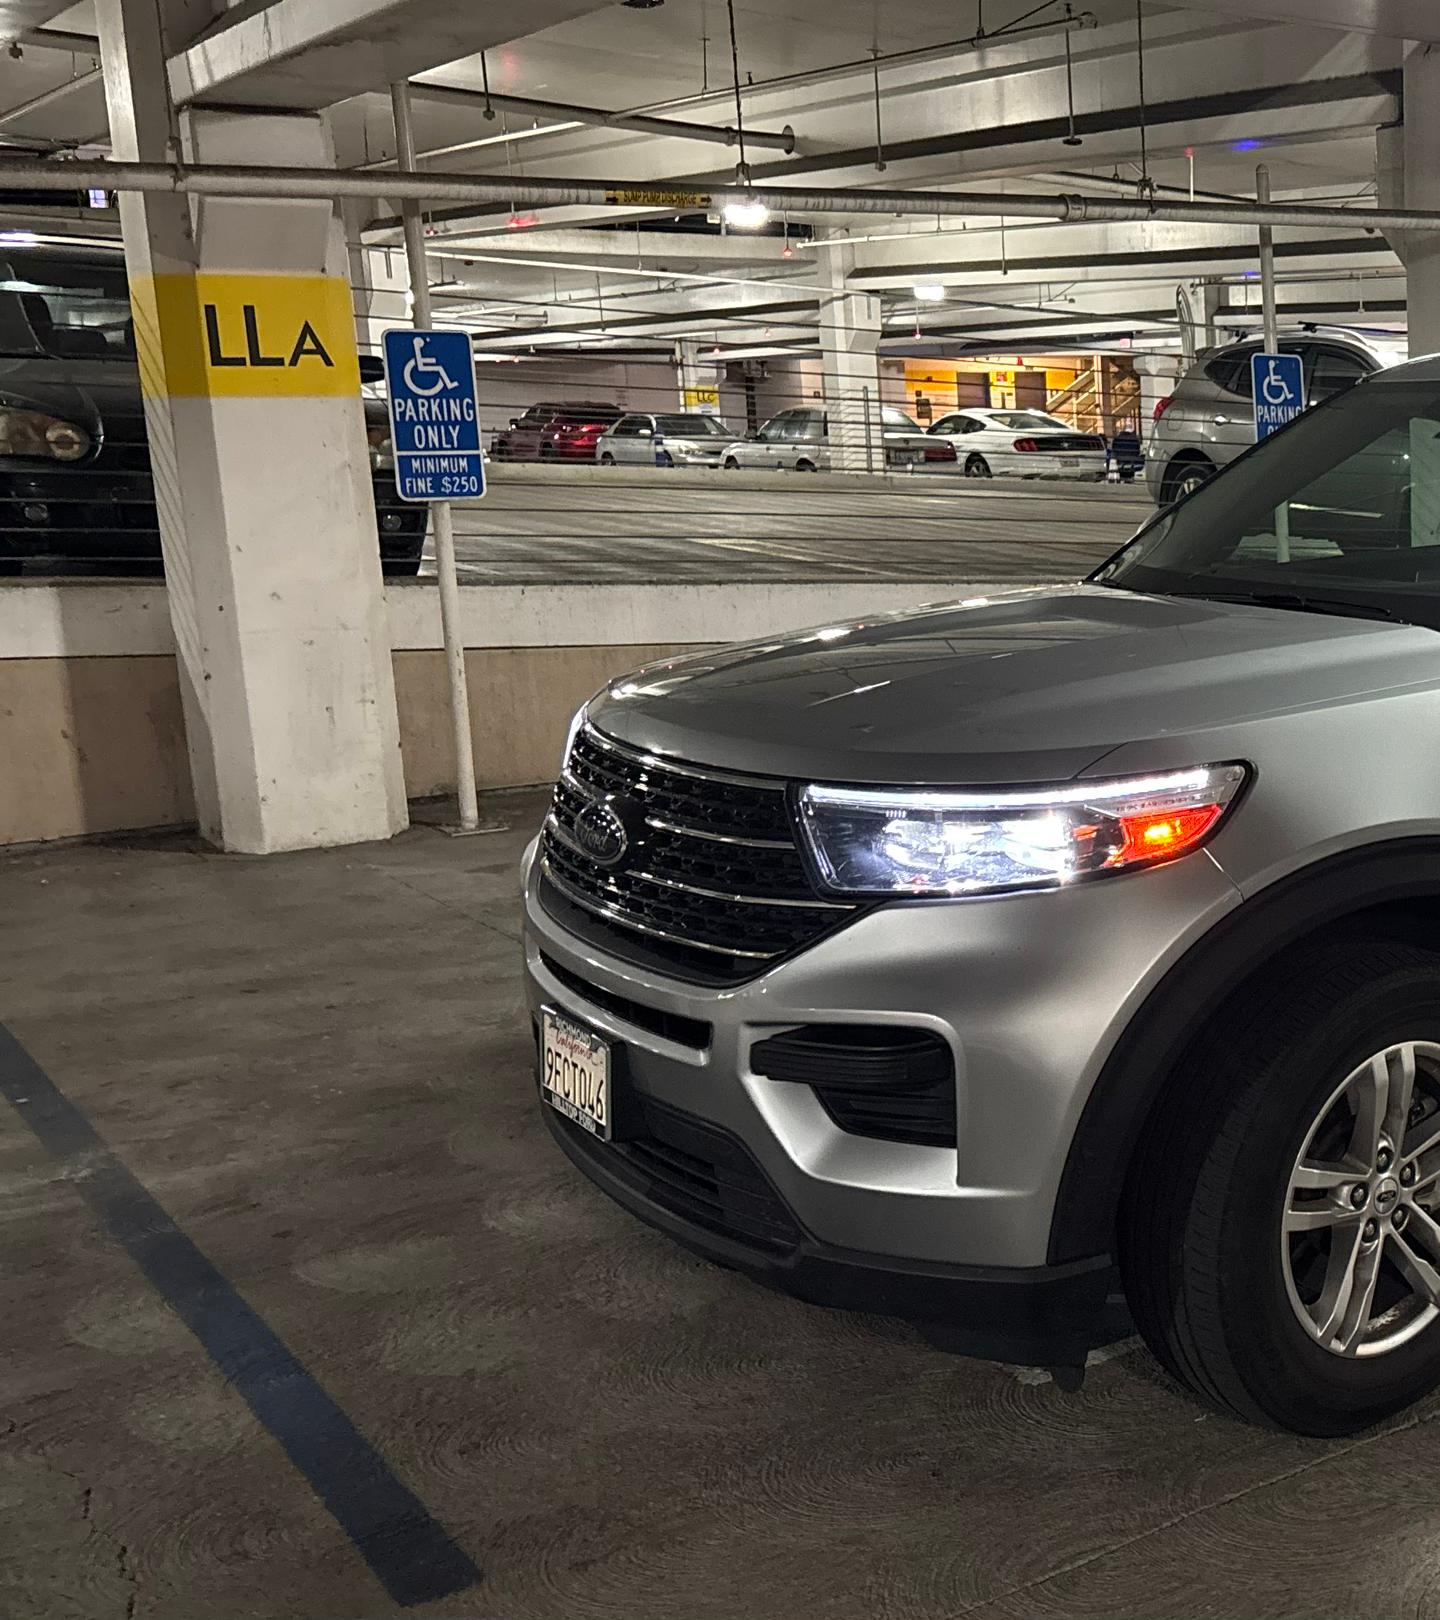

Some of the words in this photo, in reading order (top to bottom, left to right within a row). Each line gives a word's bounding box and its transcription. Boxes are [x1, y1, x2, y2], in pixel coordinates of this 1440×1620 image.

[204, 304, 334, 367] LLA
[394, 398, 474, 421] PARKING
[414, 425, 460, 448] ONLY
[411, 457, 468, 473] MINIMUM
[405, 477, 435, 494] FINE
[441, 476, 478, 494] $250
[546, 1047, 604, 1120] 9FCT046
